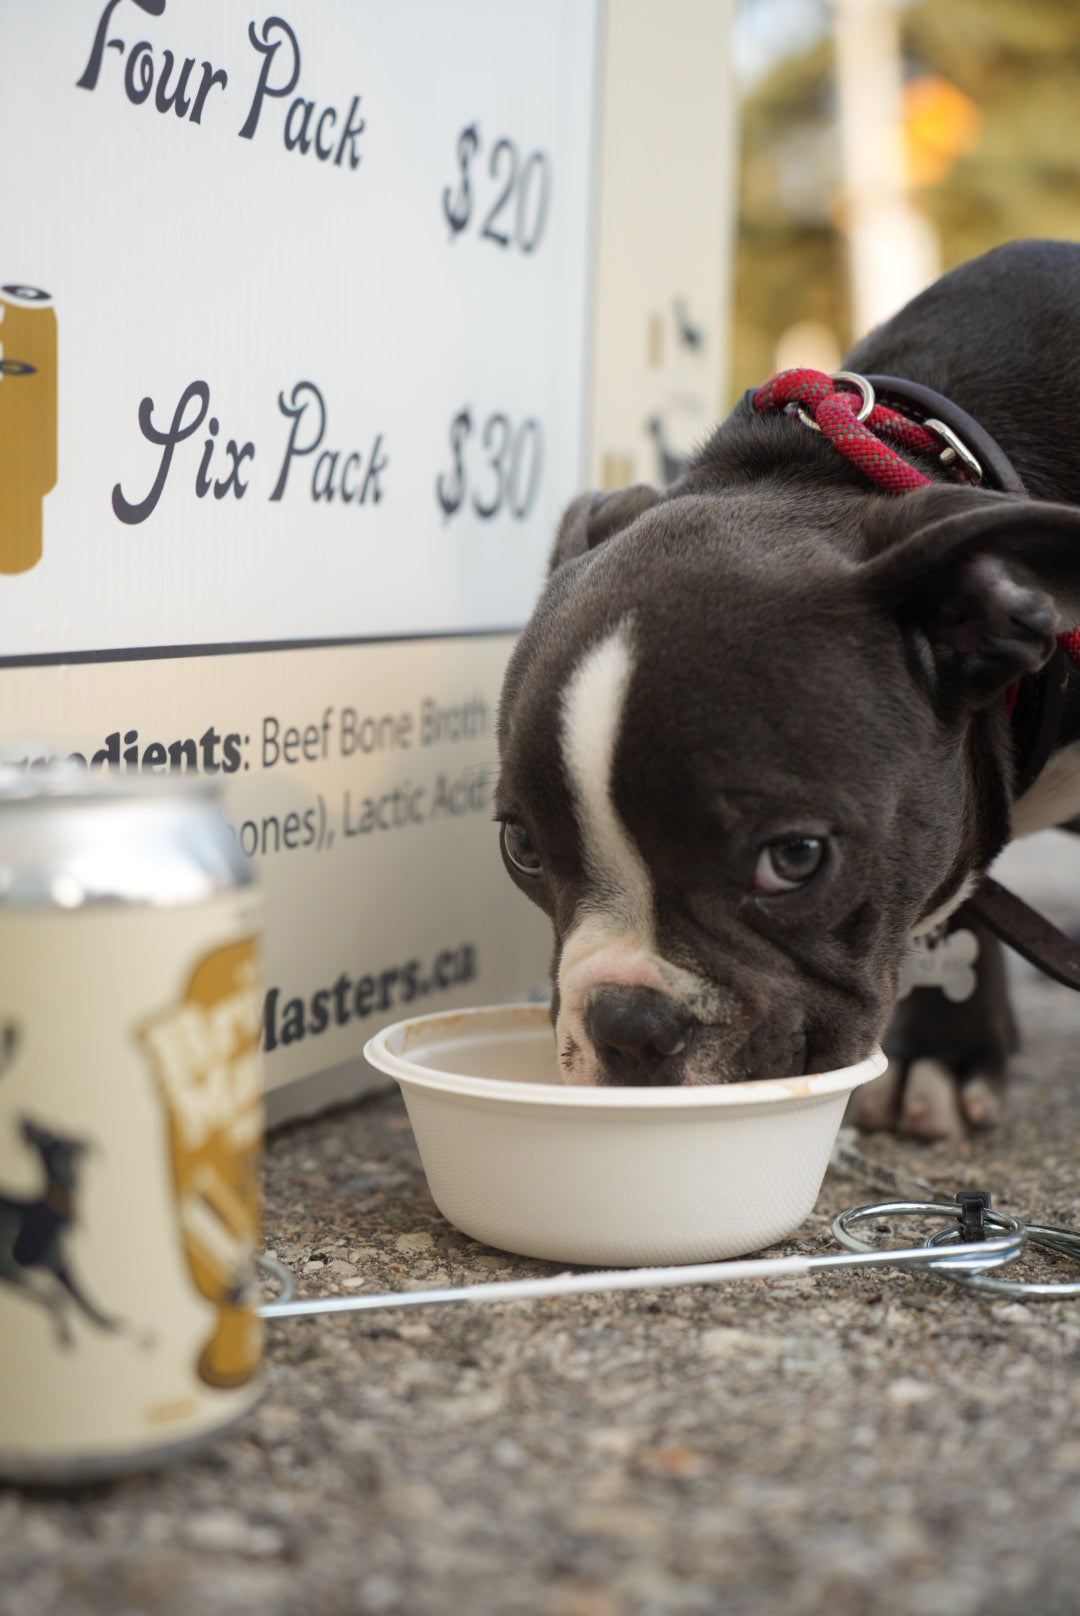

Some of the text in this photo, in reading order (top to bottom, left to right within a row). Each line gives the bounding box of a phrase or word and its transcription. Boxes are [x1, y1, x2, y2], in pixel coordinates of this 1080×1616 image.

[76, 0, 365, 171] Four Pack
[443, 122, 553, 255] $20
[112, 380, 387, 525] Six Pack
[436, 407, 544, 525] $30
[262, 708, 333, 768] Beef
[341, 706, 414, 757] Bone
[343, 778, 424, 837] Lactic
